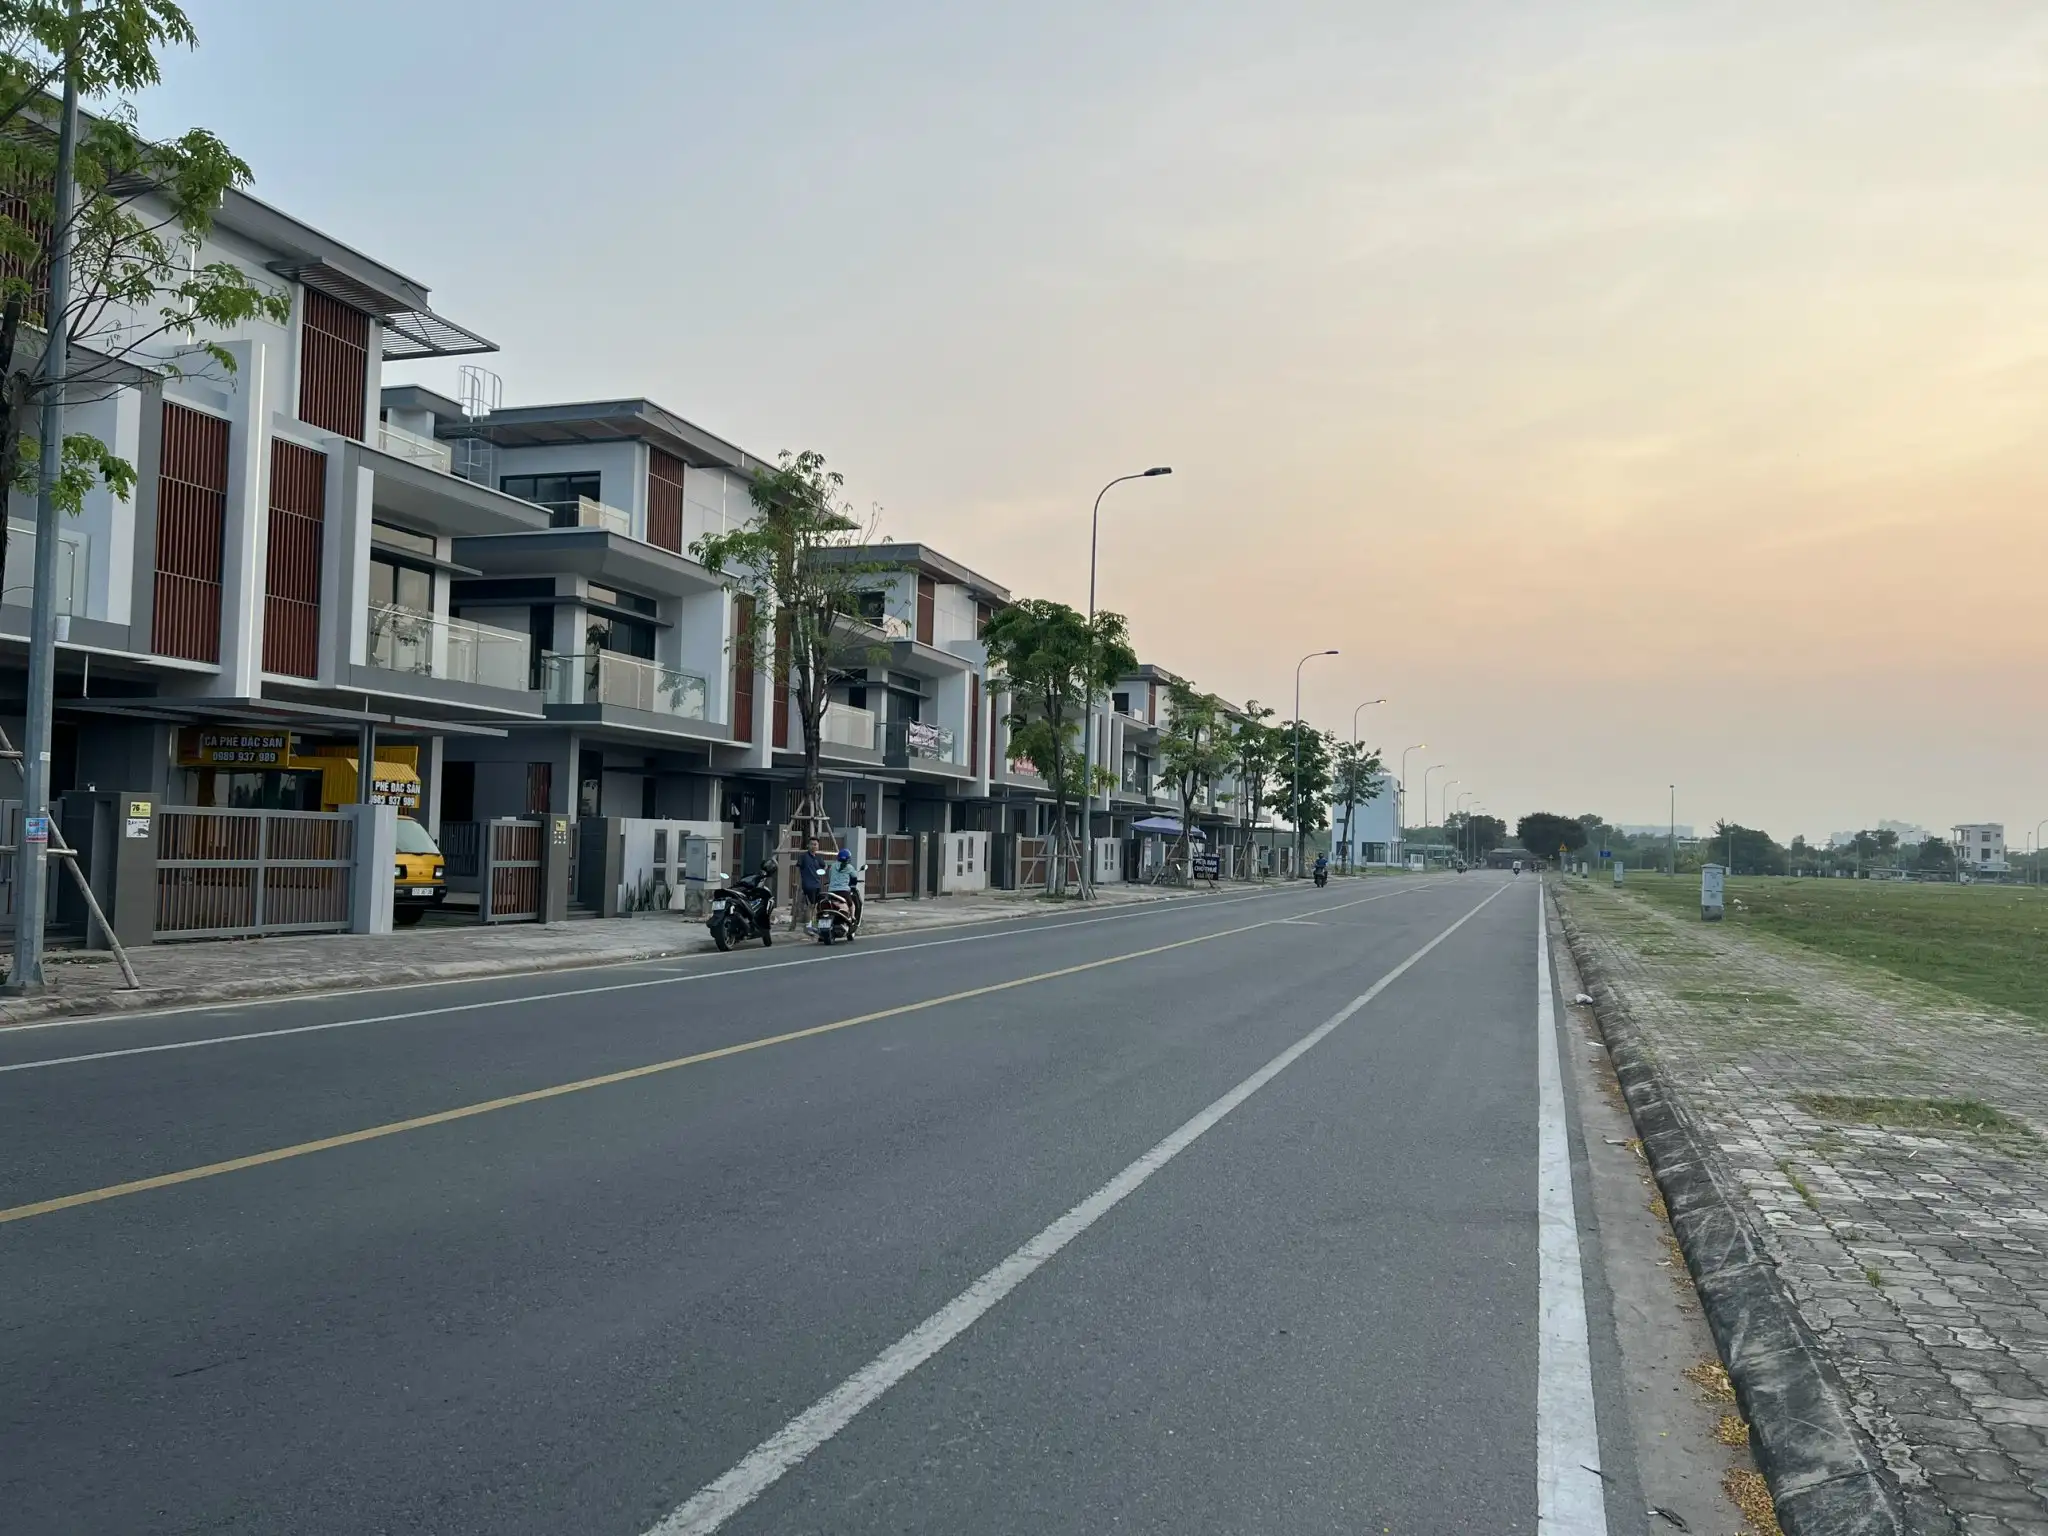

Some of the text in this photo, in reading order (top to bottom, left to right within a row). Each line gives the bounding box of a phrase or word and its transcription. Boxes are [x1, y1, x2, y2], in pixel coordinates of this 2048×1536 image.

[212, 751, 276, 762] 0989 937 989
